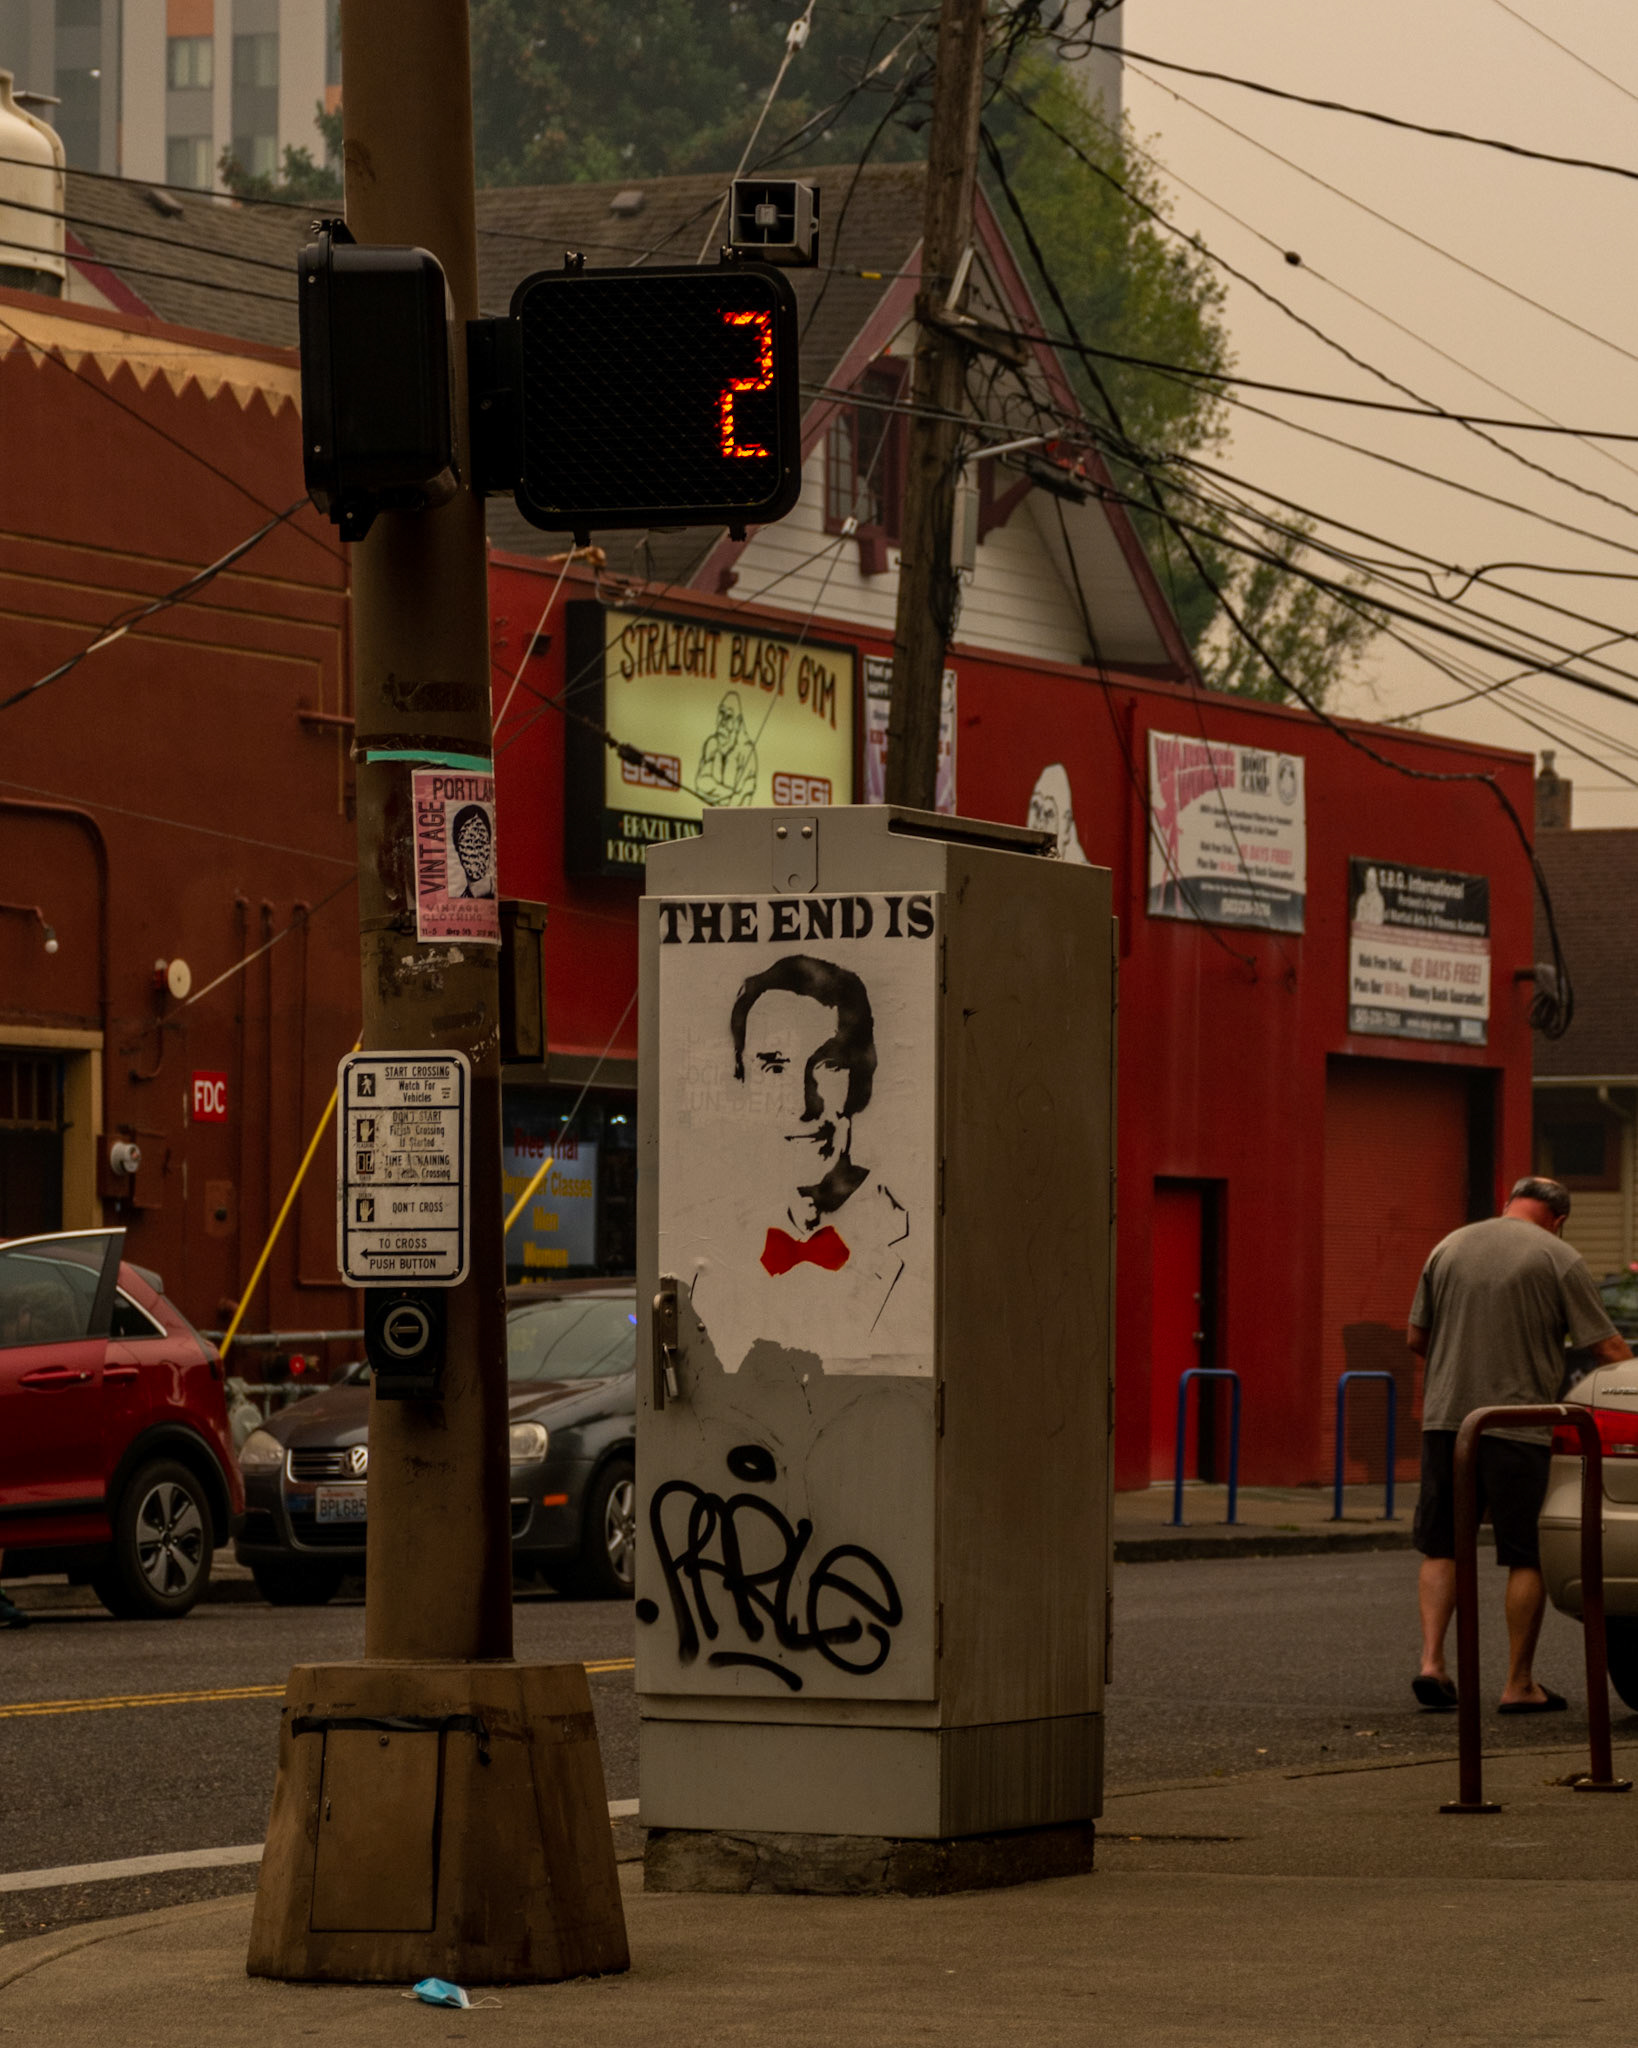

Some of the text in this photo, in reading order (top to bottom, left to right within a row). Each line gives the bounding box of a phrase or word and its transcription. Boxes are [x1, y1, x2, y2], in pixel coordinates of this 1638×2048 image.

[713, 309, 775, 459] 2
[620, 624, 837, 730] STRAIGHT BLAST GYM
[1241, 755, 1267, 774] BOOT
[1241, 774, 1269, 794] CAMP
[418, 801, 446, 896] VINTAGE
[659, 895, 935, 944] THE END IS
[1424, 957, 1452, 981] DAYS
[385, 1066, 450, 1077] START CROSSING
[399, 1080, 436, 1091] Watch For
[193, 1079, 226, 1115] FDC
[403, 1092, 432, 1103] Vehicles
[419, 1110, 442, 1122] START
[415, 1124, 445, 1138] Crossing
[513, 1128, 578, 1160] Free Trial
[385, 1155, 402, 1166] TIME
[421, 1168, 450, 1180] Crossing
[551, 1171, 592, 1198] Classes
[392, 1202, 443, 1213] DON'T CROSS
[379, 1238, 427, 1249] TO CROSS
[369, 1258, 436, 1270] PUSH BUTTON
